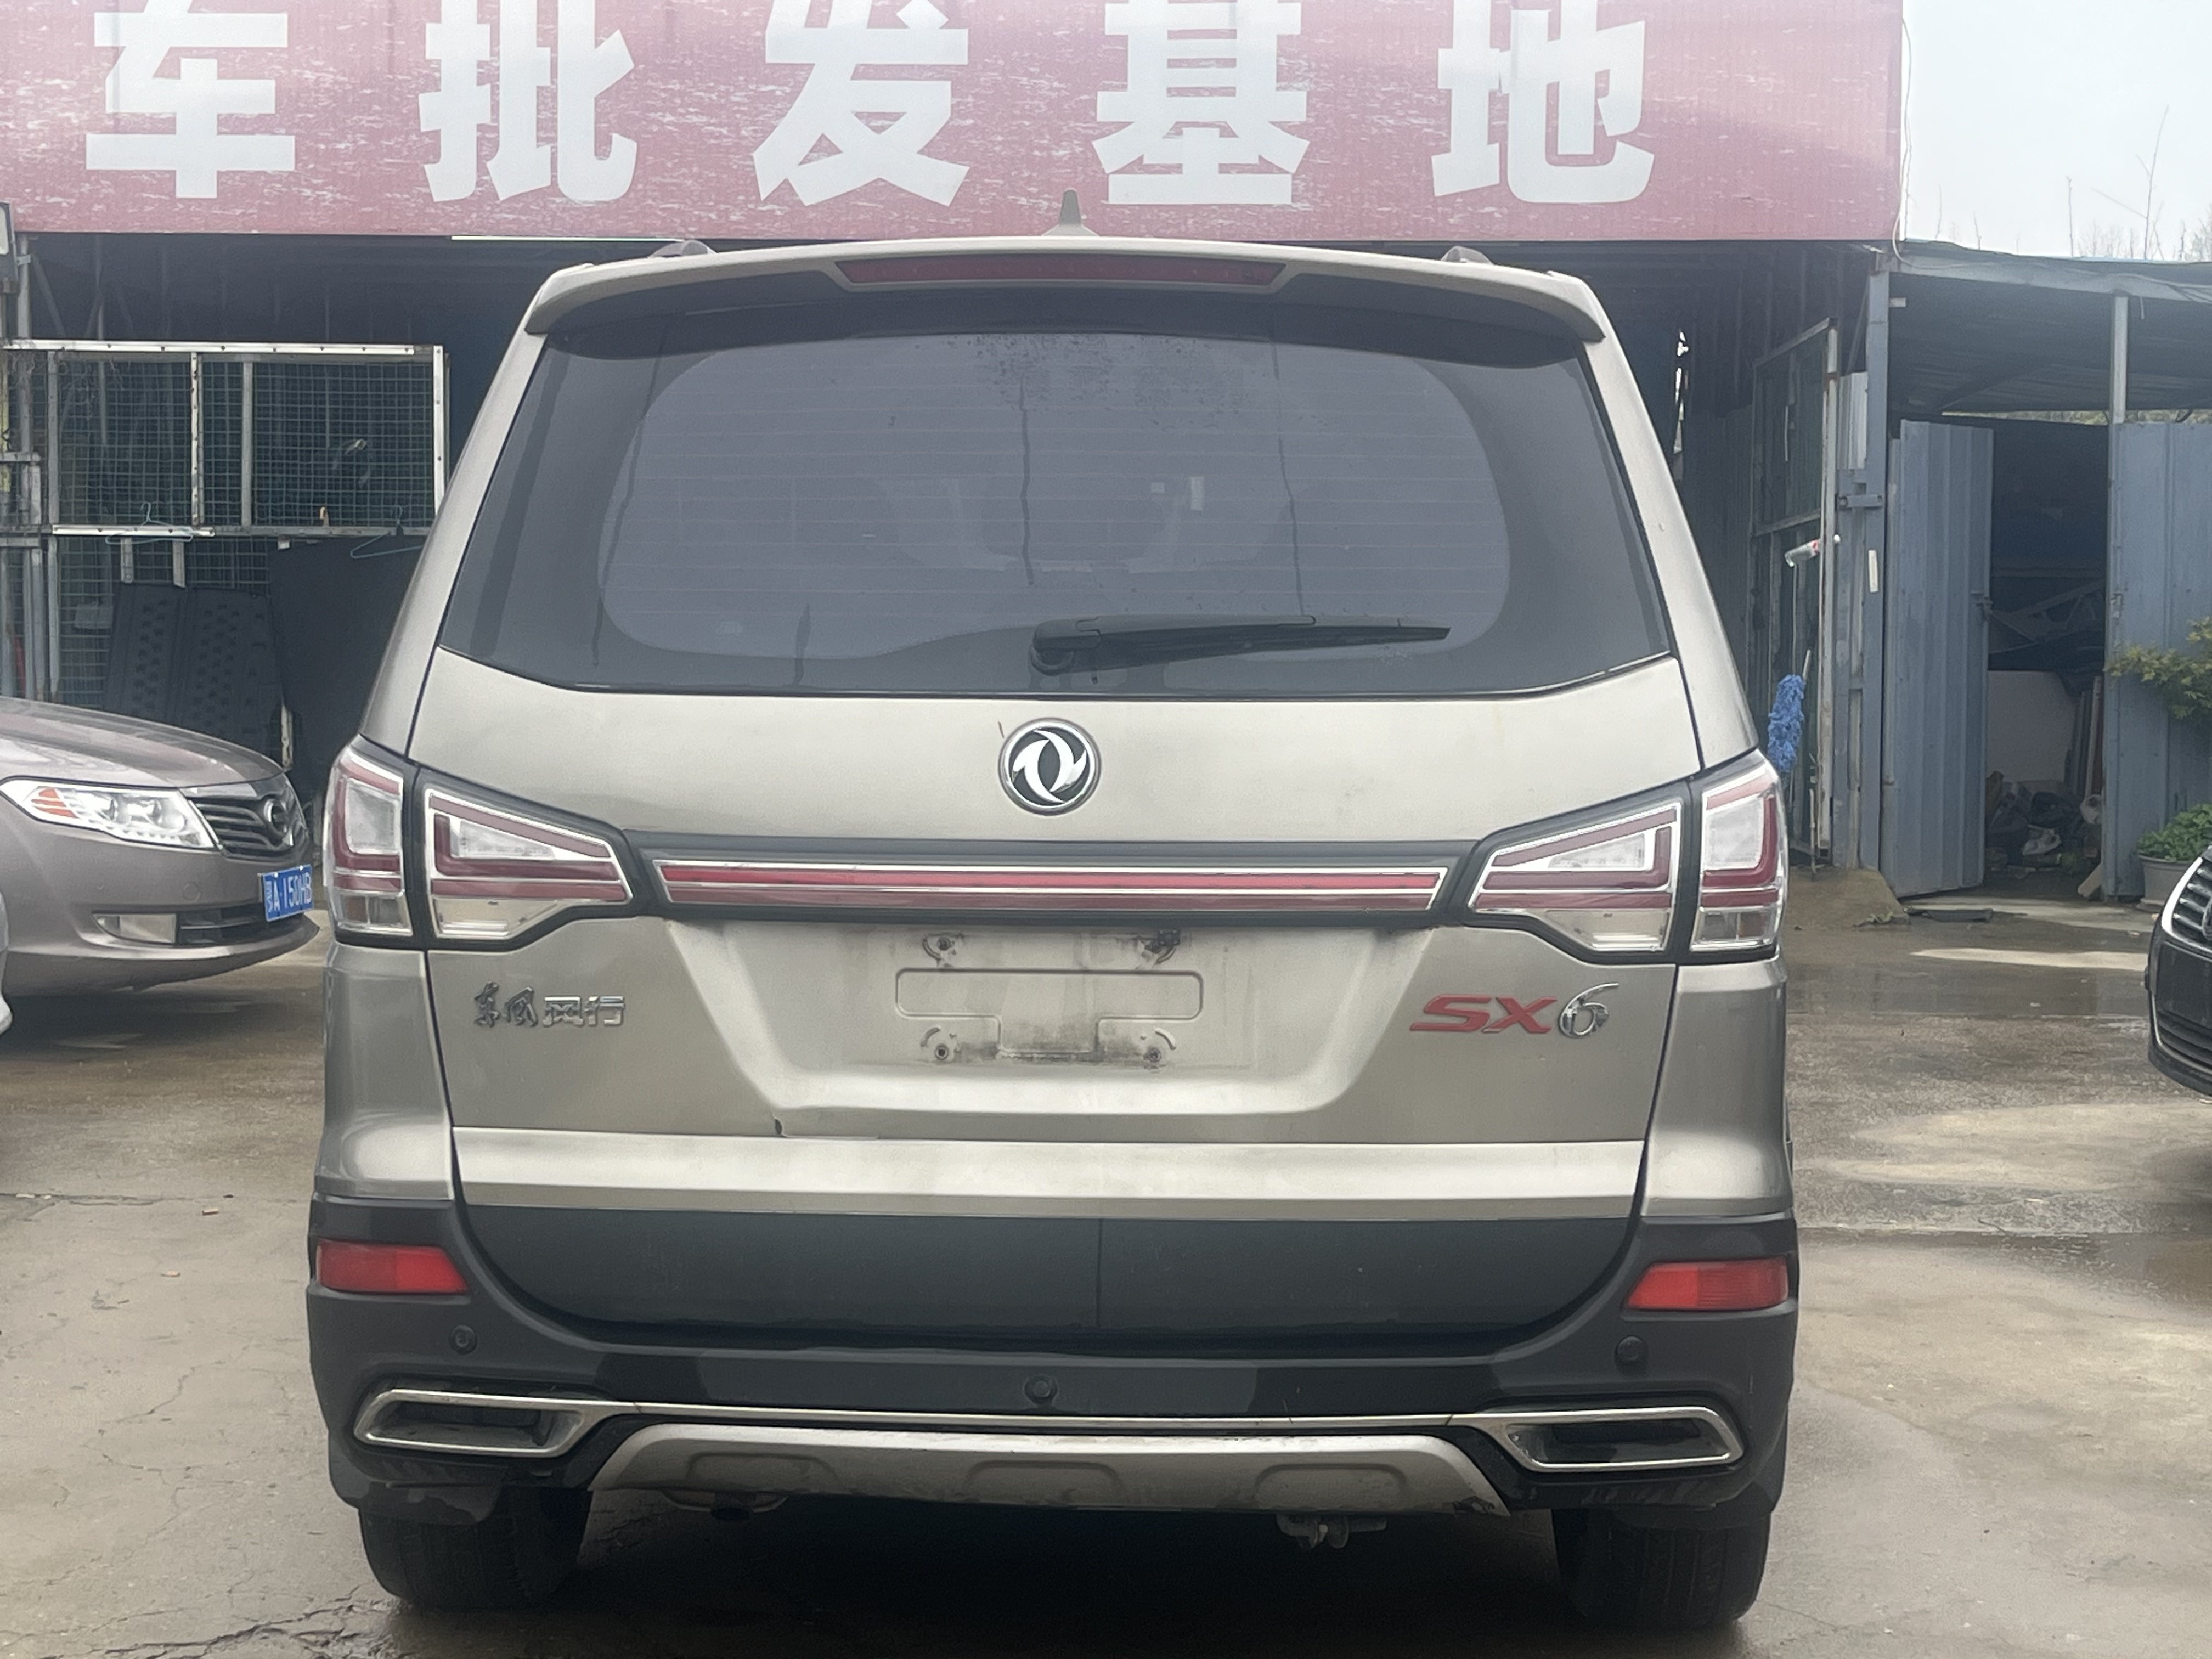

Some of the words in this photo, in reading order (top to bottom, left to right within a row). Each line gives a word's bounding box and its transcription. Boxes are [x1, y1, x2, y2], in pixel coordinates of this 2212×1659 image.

[85, 0, 1654, 206] 车批发基地
[1409, 983, 1620, 1038] SX6
